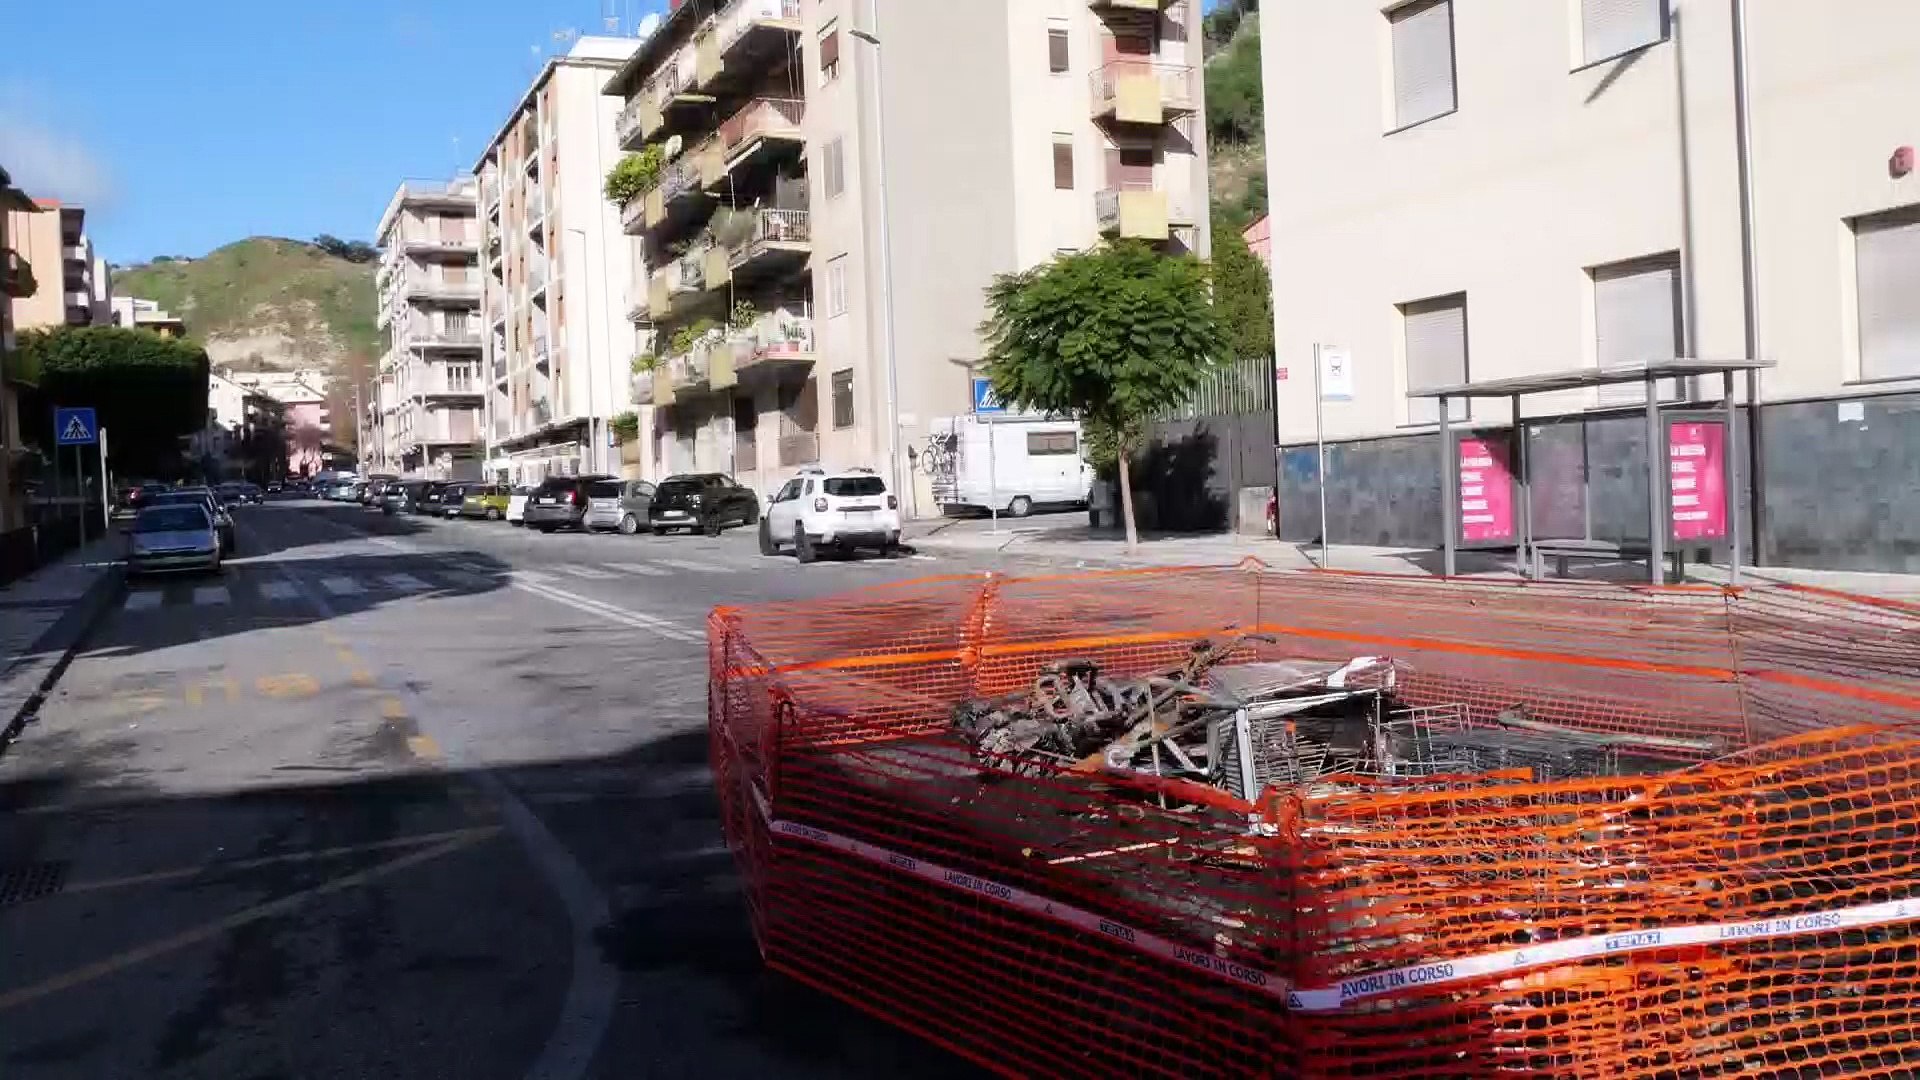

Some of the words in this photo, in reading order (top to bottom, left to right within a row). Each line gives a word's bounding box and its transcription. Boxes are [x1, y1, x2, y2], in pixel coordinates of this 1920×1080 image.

[944, 871, 972, 889] LAVORI
[974, 879, 983, 890] IN
[984, 883, 1012, 900] CORSO
[1720, 923, 1771, 939] LAVORI
[1775, 919, 1791, 933] IN
[1795, 912, 1841, 930] CORSO
[1172, 944, 1211, 969] LAVORI
[1214, 959, 1227, 974] IN
[1228, 963, 1267, 986] CORSO
[1340, 976, 1386, 998] AVORI
[1389, 971, 1405, 986] IN
[1408, 964, 1454, 983] CORSO
